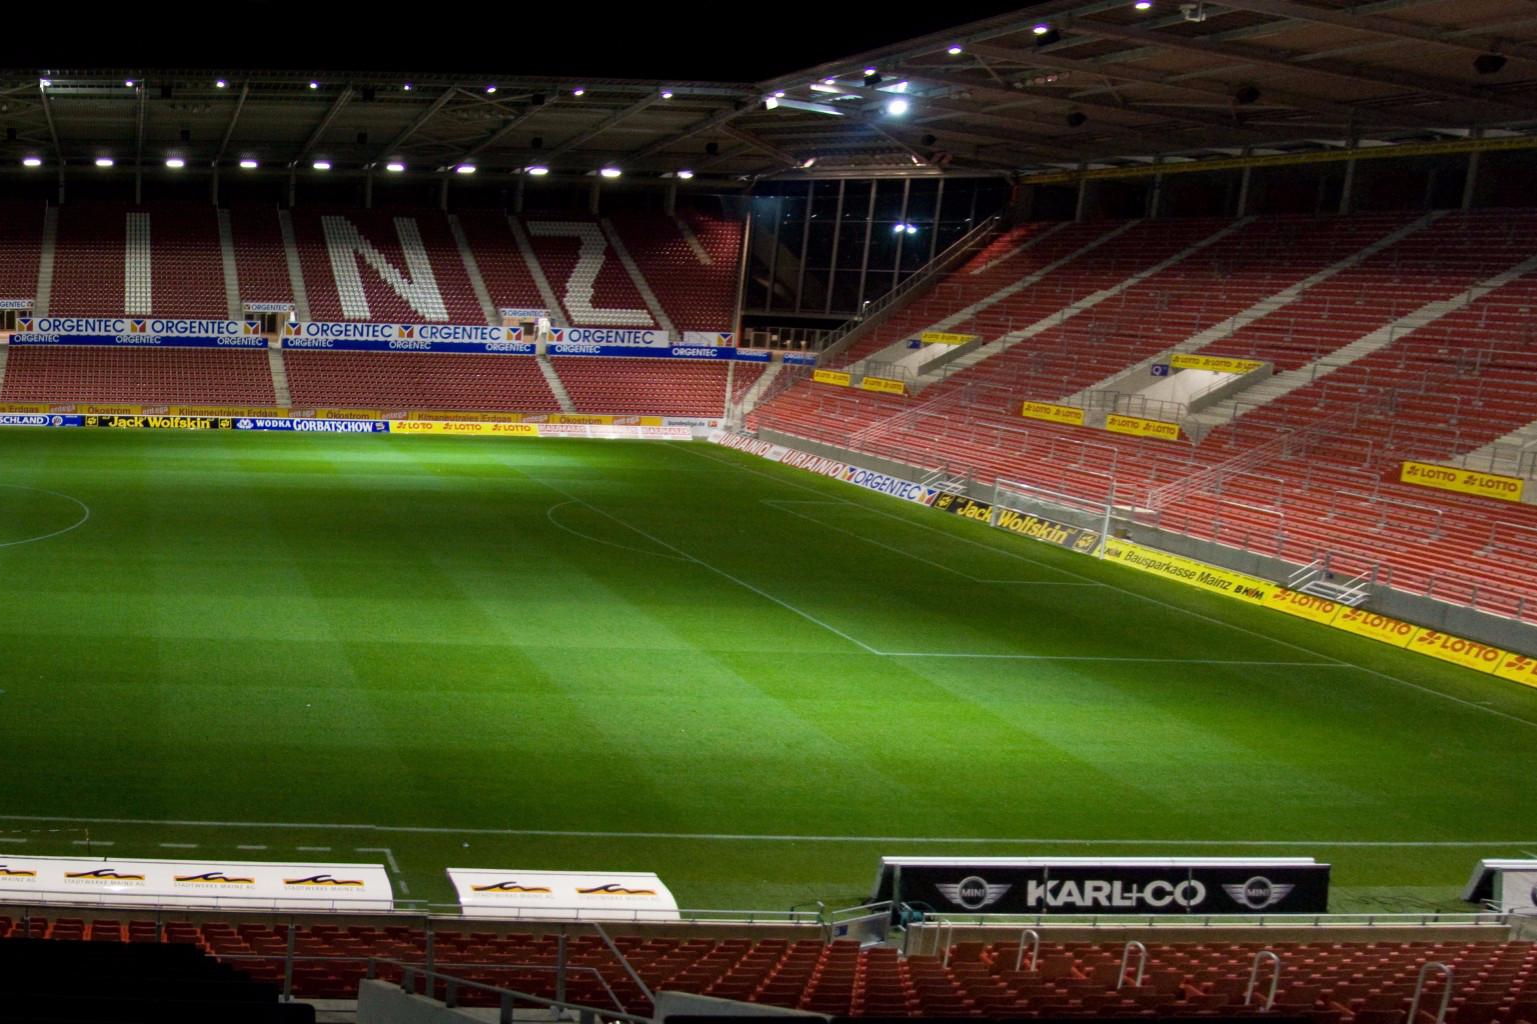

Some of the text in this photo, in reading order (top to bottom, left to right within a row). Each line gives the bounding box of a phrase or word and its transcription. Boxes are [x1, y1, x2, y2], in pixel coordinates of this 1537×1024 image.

[38, 319, 125, 333] ORGENTEC
[152, 320, 238, 334] ORGENTEC
[307, 323, 393, 338] ORGENTEC
[14, 334, 59, 342] ORGENTEC
[116, 335, 161, 343] ORGENTEC
[217, 337, 263, 345] ORGENTEC
[288, 339, 334, 347] ORGENTEC
[569, 329, 654, 345] ORGENTEC
[485, 343, 530, 352] ORGENTEC
[555, 345, 600, 354] ORGENTEC
[673, 347, 717, 357] ORGENTEC
[109, 416, 210, 429] Jack Wolfskin
[256, 418, 374, 432] WODKA GORBATSCHOW
[454, 423, 482, 431] LOTTO
[1118, 419, 1139, 429] LOTTO
[1153, 425, 1176, 435] LOTTO
[1421, 468, 1456, 482] LOTTO
[854, 471, 921, 500] ORGENTEC
[1479, 479, 1518, 493] LOTTO
[957, 500, 1069, 544] Jack Wolfskin
[1124, 549, 1197, 580] Bausparkasse
[1197, 571, 1233, 591] Mainz
[1290, 592, 1335, 614] LOTTO
[1363, 614, 1412, 636] LOTTO
[1440, 637, 1499, 662] LOTTO
[961, 888, 985, 897] MINI
[1026, 880, 1206, 907] KARL+CO
[1246, 888, 1270, 897] MINI
